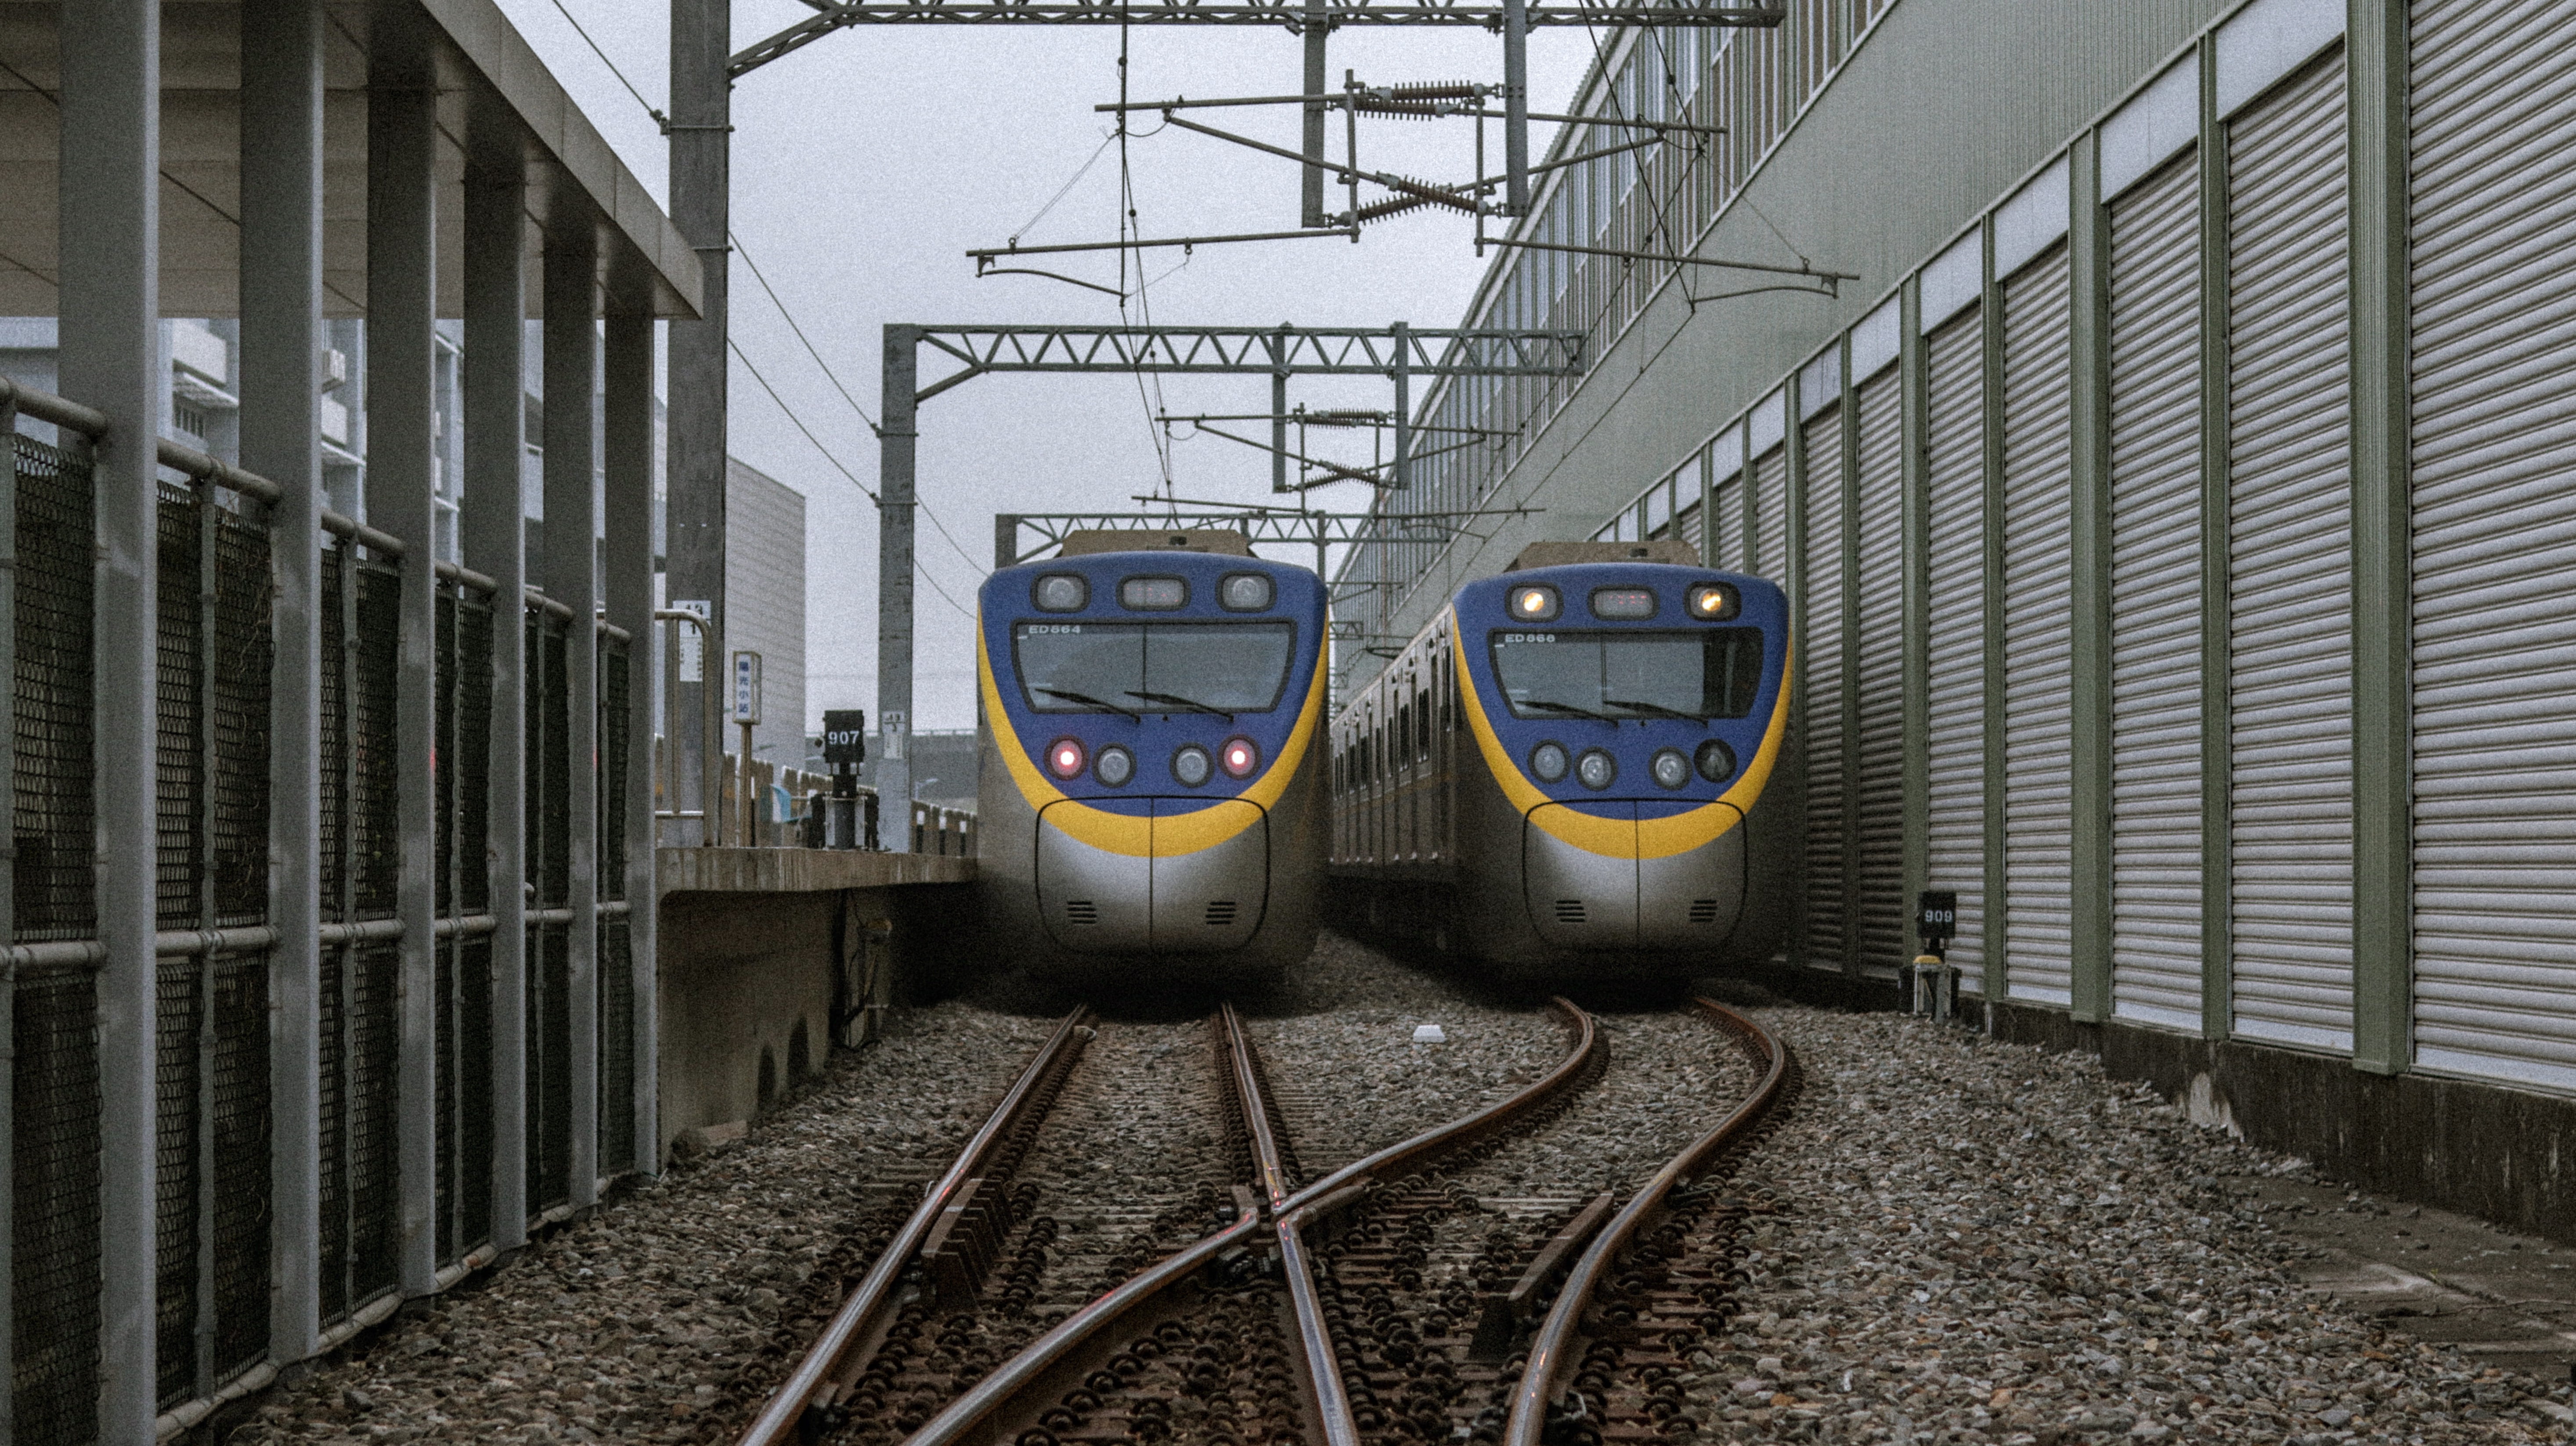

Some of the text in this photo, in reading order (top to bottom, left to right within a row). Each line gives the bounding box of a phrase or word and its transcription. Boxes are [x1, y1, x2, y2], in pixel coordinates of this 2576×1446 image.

[1028, 625, 1081, 634] ED864
[1504, 634, 1555, 643] ED868
[828, 731, 859, 744] 907
[1925, 910, 1952, 923] 909
